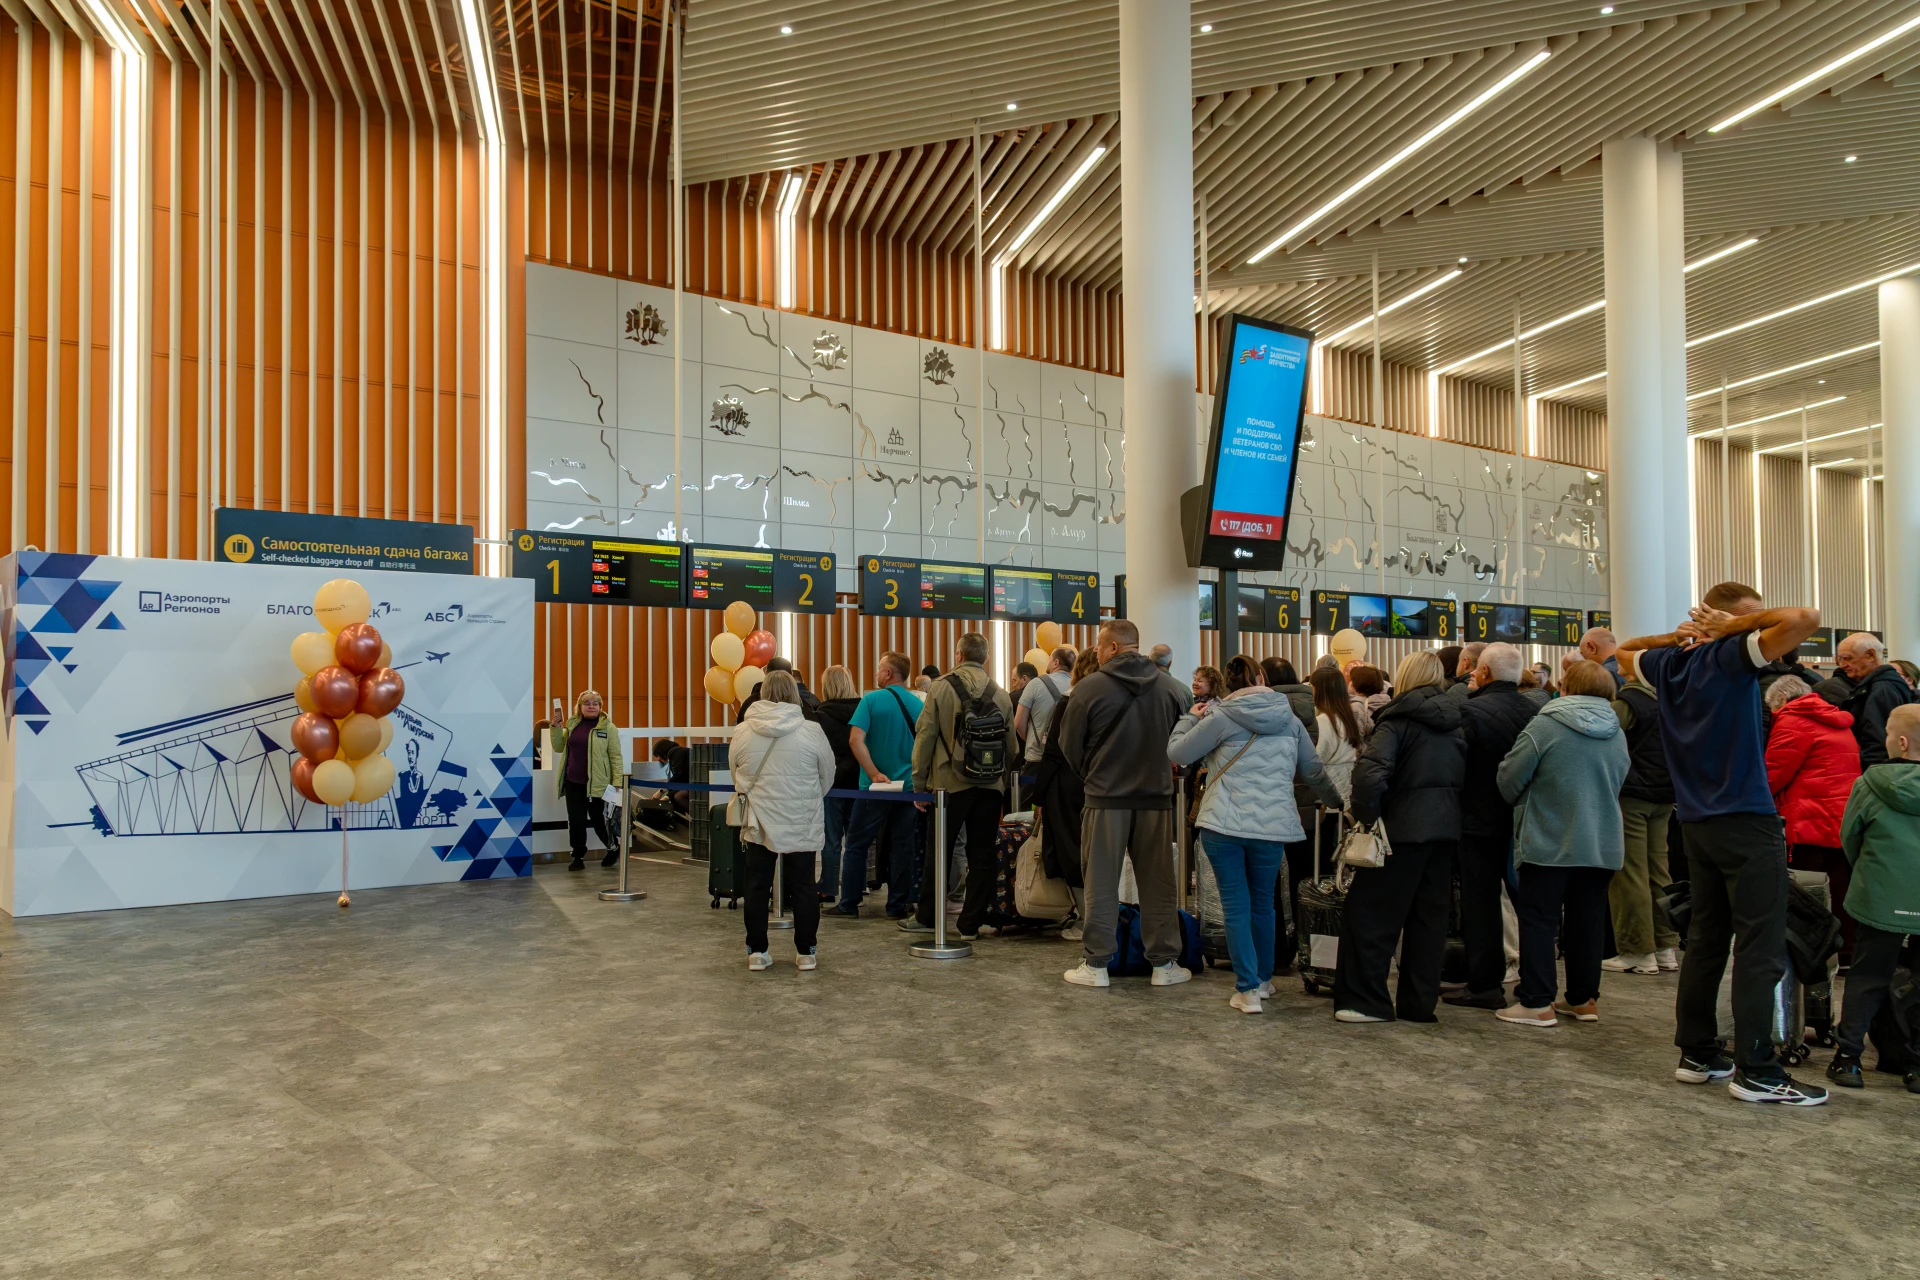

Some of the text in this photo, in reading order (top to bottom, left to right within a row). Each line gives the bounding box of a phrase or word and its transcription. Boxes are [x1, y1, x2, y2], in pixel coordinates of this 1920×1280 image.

[1246, 417, 1276, 429] ПОМОЩЬ
[1242, 427, 1282, 440] ПОДДЕРЖКА
[1232, 437, 1283, 451] ВЕТЕРАНОВ СВО
[1224, 447, 1288, 462] И ЧЛЕНОВ ИХ СЕМЕЙ
[1229, 520, 1272, 536] 117 (ДОБ. 1)
[538, 535, 585, 547] Регистрация
[261, 536, 469, 562] Самостоятельная сдача багажа
[261, 553, 374, 568] Self-checked baggage drop off
[779, 552, 817, 563] Регистрация
[882, 559, 916, 569] Регистрация
[546, 559, 560, 595] 1
[1057, 572, 1086, 581] Регистрация
[798, 573, 813, 605] 2
[884, 578, 899, 610] 3
[164, 593, 231, 605] Аэропорты
[1070, 591, 1084, 619] 4
[164, 603, 220, 614] Регионов
[424, 612, 455, 622] АБС
[1278, 604, 1289, 629] 6
[1328, 607, 1338, 631] 7
[1439, 615, 1447, 637] 8
[1478, 616, 1487, 638] 9
[1565, 622, 1579, 643] 10
